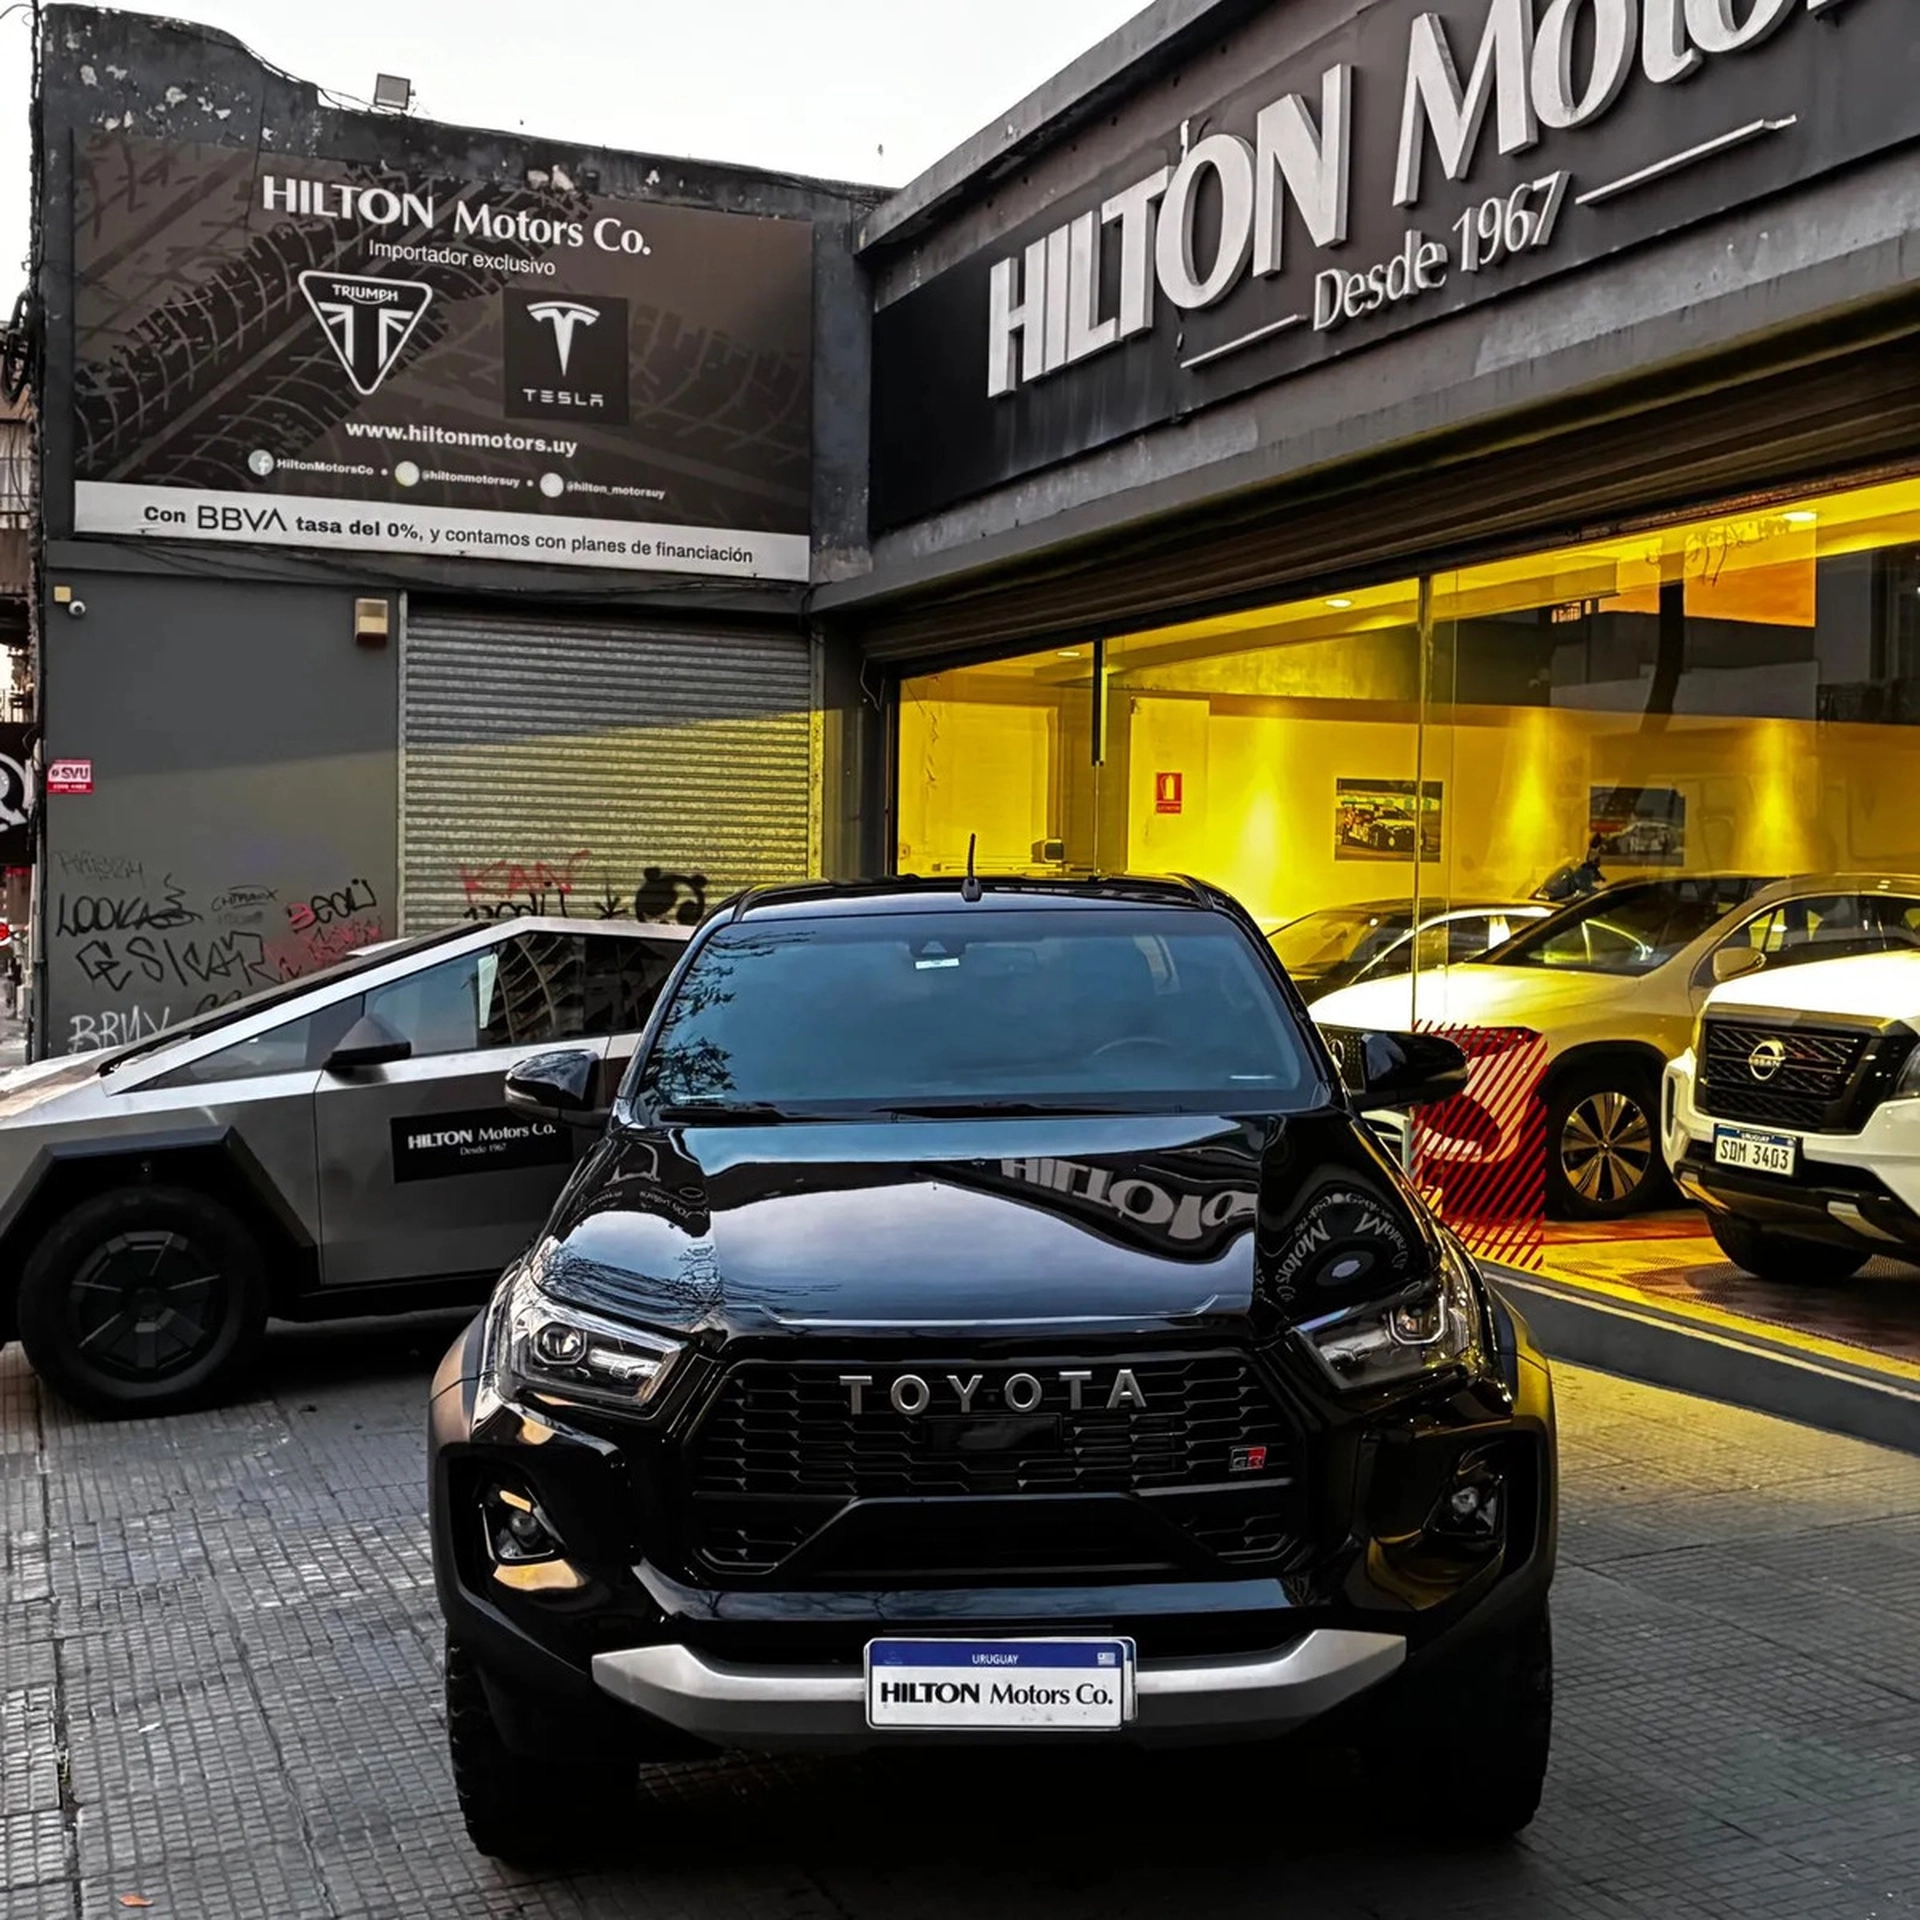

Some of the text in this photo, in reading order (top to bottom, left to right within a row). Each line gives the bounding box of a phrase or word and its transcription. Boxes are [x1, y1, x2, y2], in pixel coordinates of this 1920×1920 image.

[263, 175, 651, 255] HILTON Motors Co.
[988, 64, 1352, 397] HILTON
[368, 239, 556, 276] Importador exclusivo
[1312, 170, 1572, 331] Desde 1967
[332, 283, 398, 304] TRIUMPH
[522, 388, 604, 407] TESLA
[345, 423, 578, 457] www.hiltonmotors.uy
[277, 458, 375, 475] HiltonMotorsCo
[144, 504, 753, 563] Con BBVA tasa del 0%, y contamos con planes de financiación
[61, 766, 89, 780] SVU
[408, 1123, 556, 1149] HILTON Motors Co.
[1752, 1144, 1789, 1170] 3403
[839, 1368, 1147, 1415] TOYOTA
[972, 1653, 1019, 1665] URUGUAY
[881, 1682, 1113, 1705] HILTON Motors Co.
